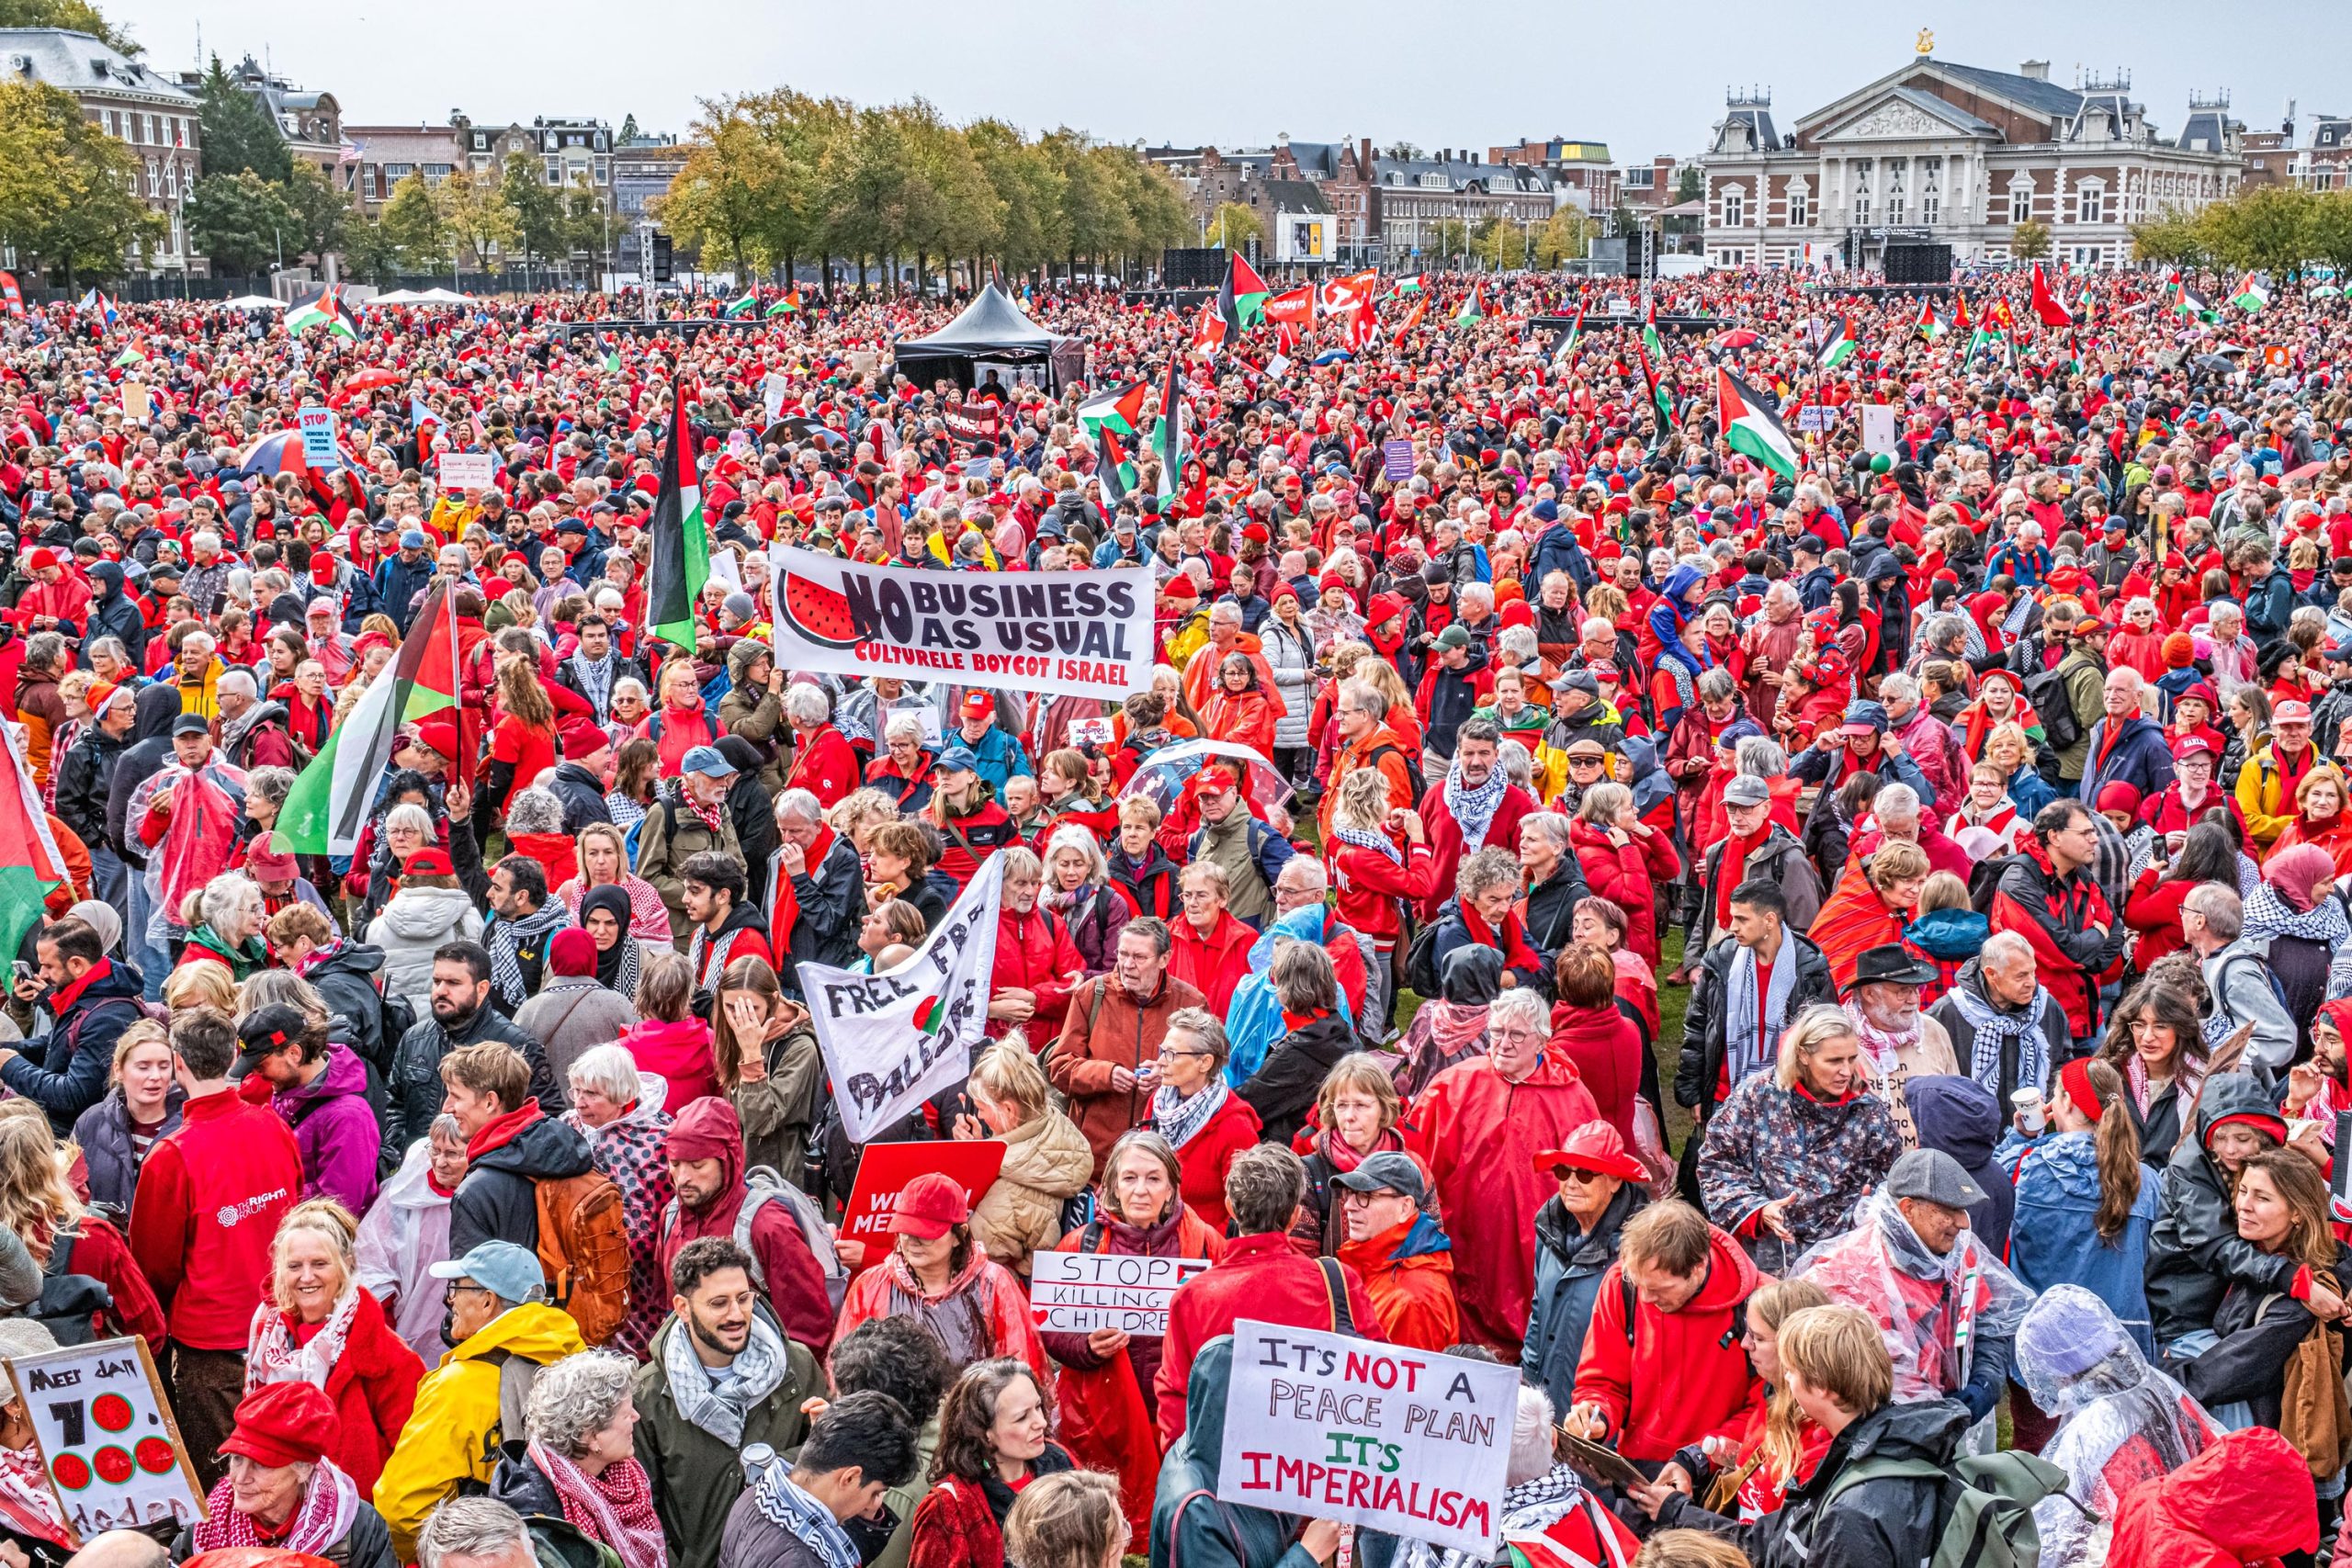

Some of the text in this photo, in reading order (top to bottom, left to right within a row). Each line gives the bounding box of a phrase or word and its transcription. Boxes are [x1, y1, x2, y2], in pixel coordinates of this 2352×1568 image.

[304, 413, 328, 426] STOP
[842, 570, 1136, 644] NO BUSINESS
[921, 618, 1132, 660] AS USUAL
[854, 641, 1129, 687] CULTURELE BOYCOT ISRAEL
[824, 976, 920, 1019] FREE
[237, 1199, 250, 1212] THE
[239, 1202, 266, 1221] FORUM
[1060, 1256, 1170, 1285] STOP
[1258, 1337, 1476, 1404] IT'S NOT A
[1270, 1378, 1495, 1447] PEACE PLAN
[1325, 1431, 1403, 1473] IT'S
[1240, 1451, 1490, 1538] IMPERIALISM
